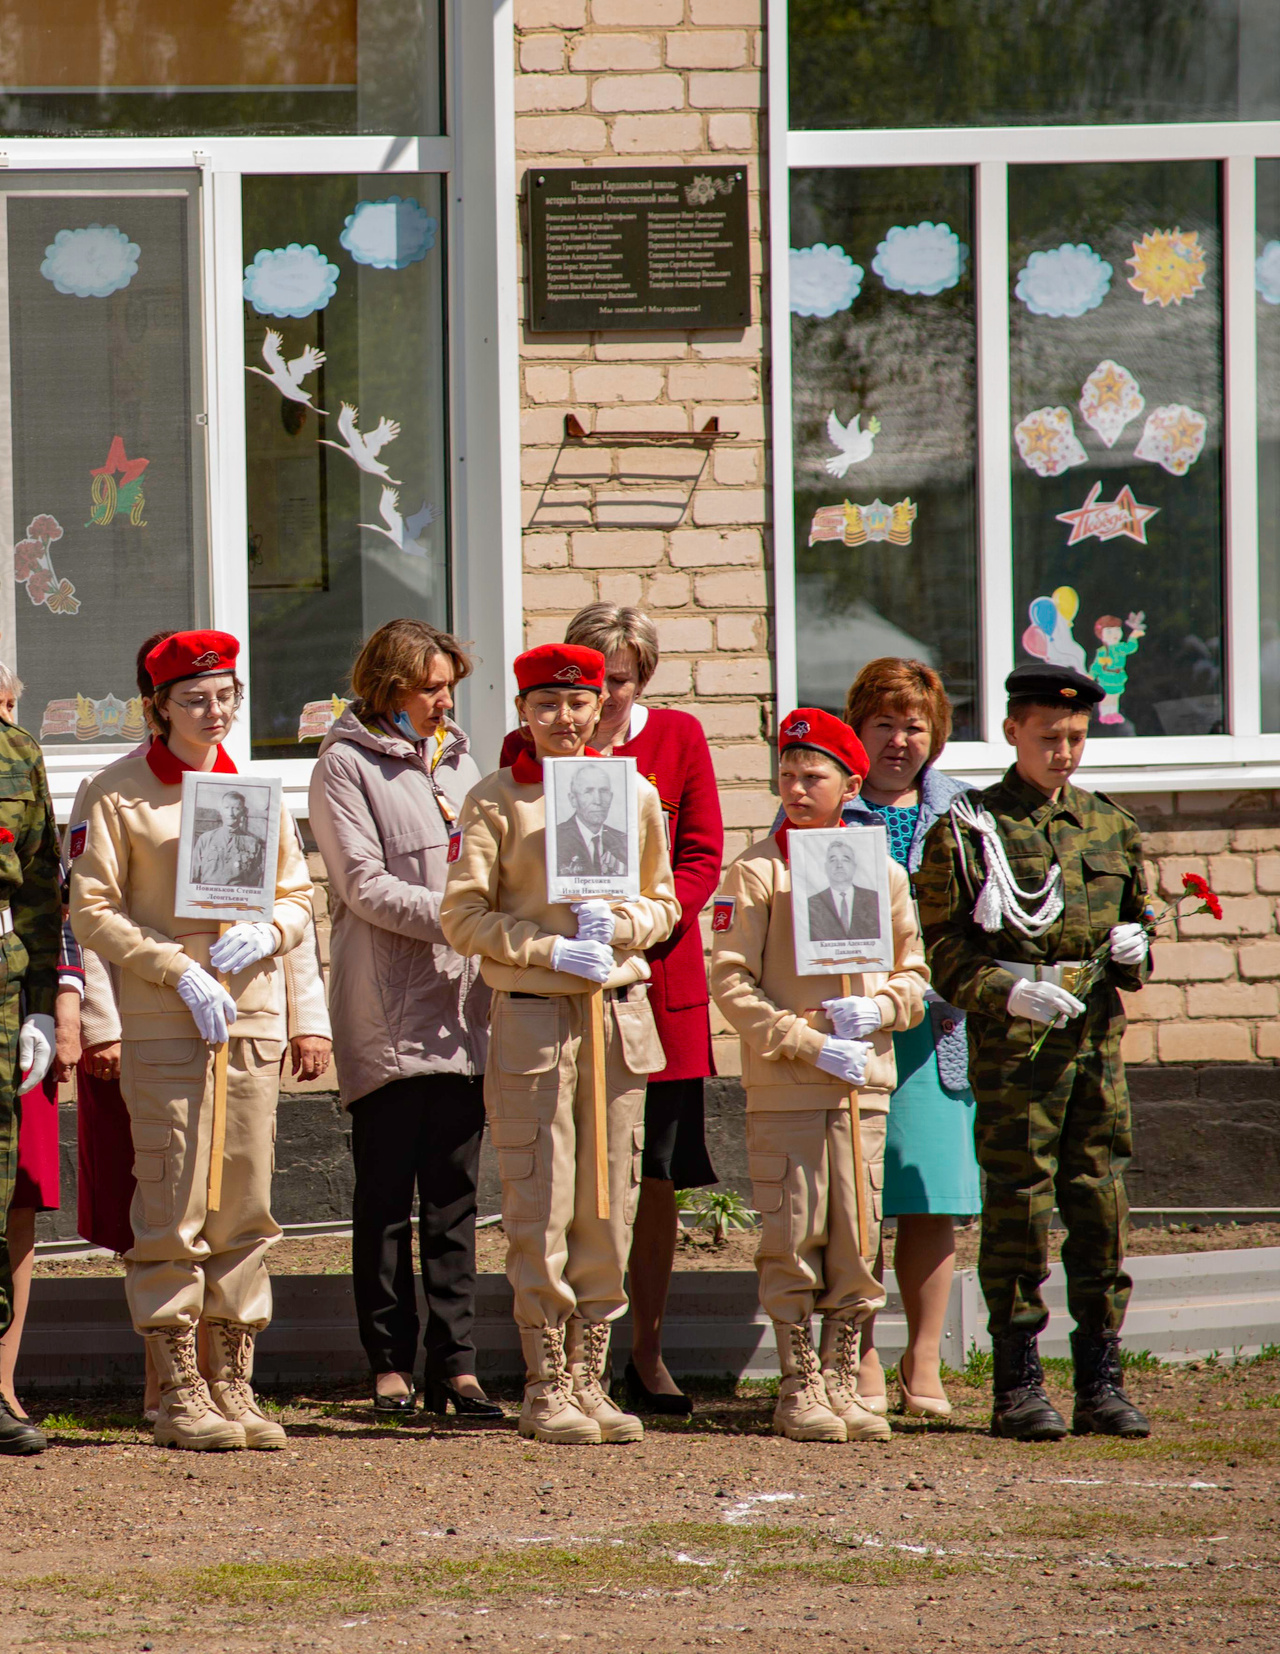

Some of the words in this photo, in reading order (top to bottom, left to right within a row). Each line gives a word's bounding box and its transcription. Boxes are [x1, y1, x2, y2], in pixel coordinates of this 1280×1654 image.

[546, 197, 576, 207] ветераны
[578, 195, 605, 204] Великой
[607, 194, 656, 203] Отечественной
[658, 194, 679, 203] войны
[664, 305, 701, 314] гордимся!
[196, 885, 235, 893] Новиньков
[207, 894, 249, 902] Леонтьевич
